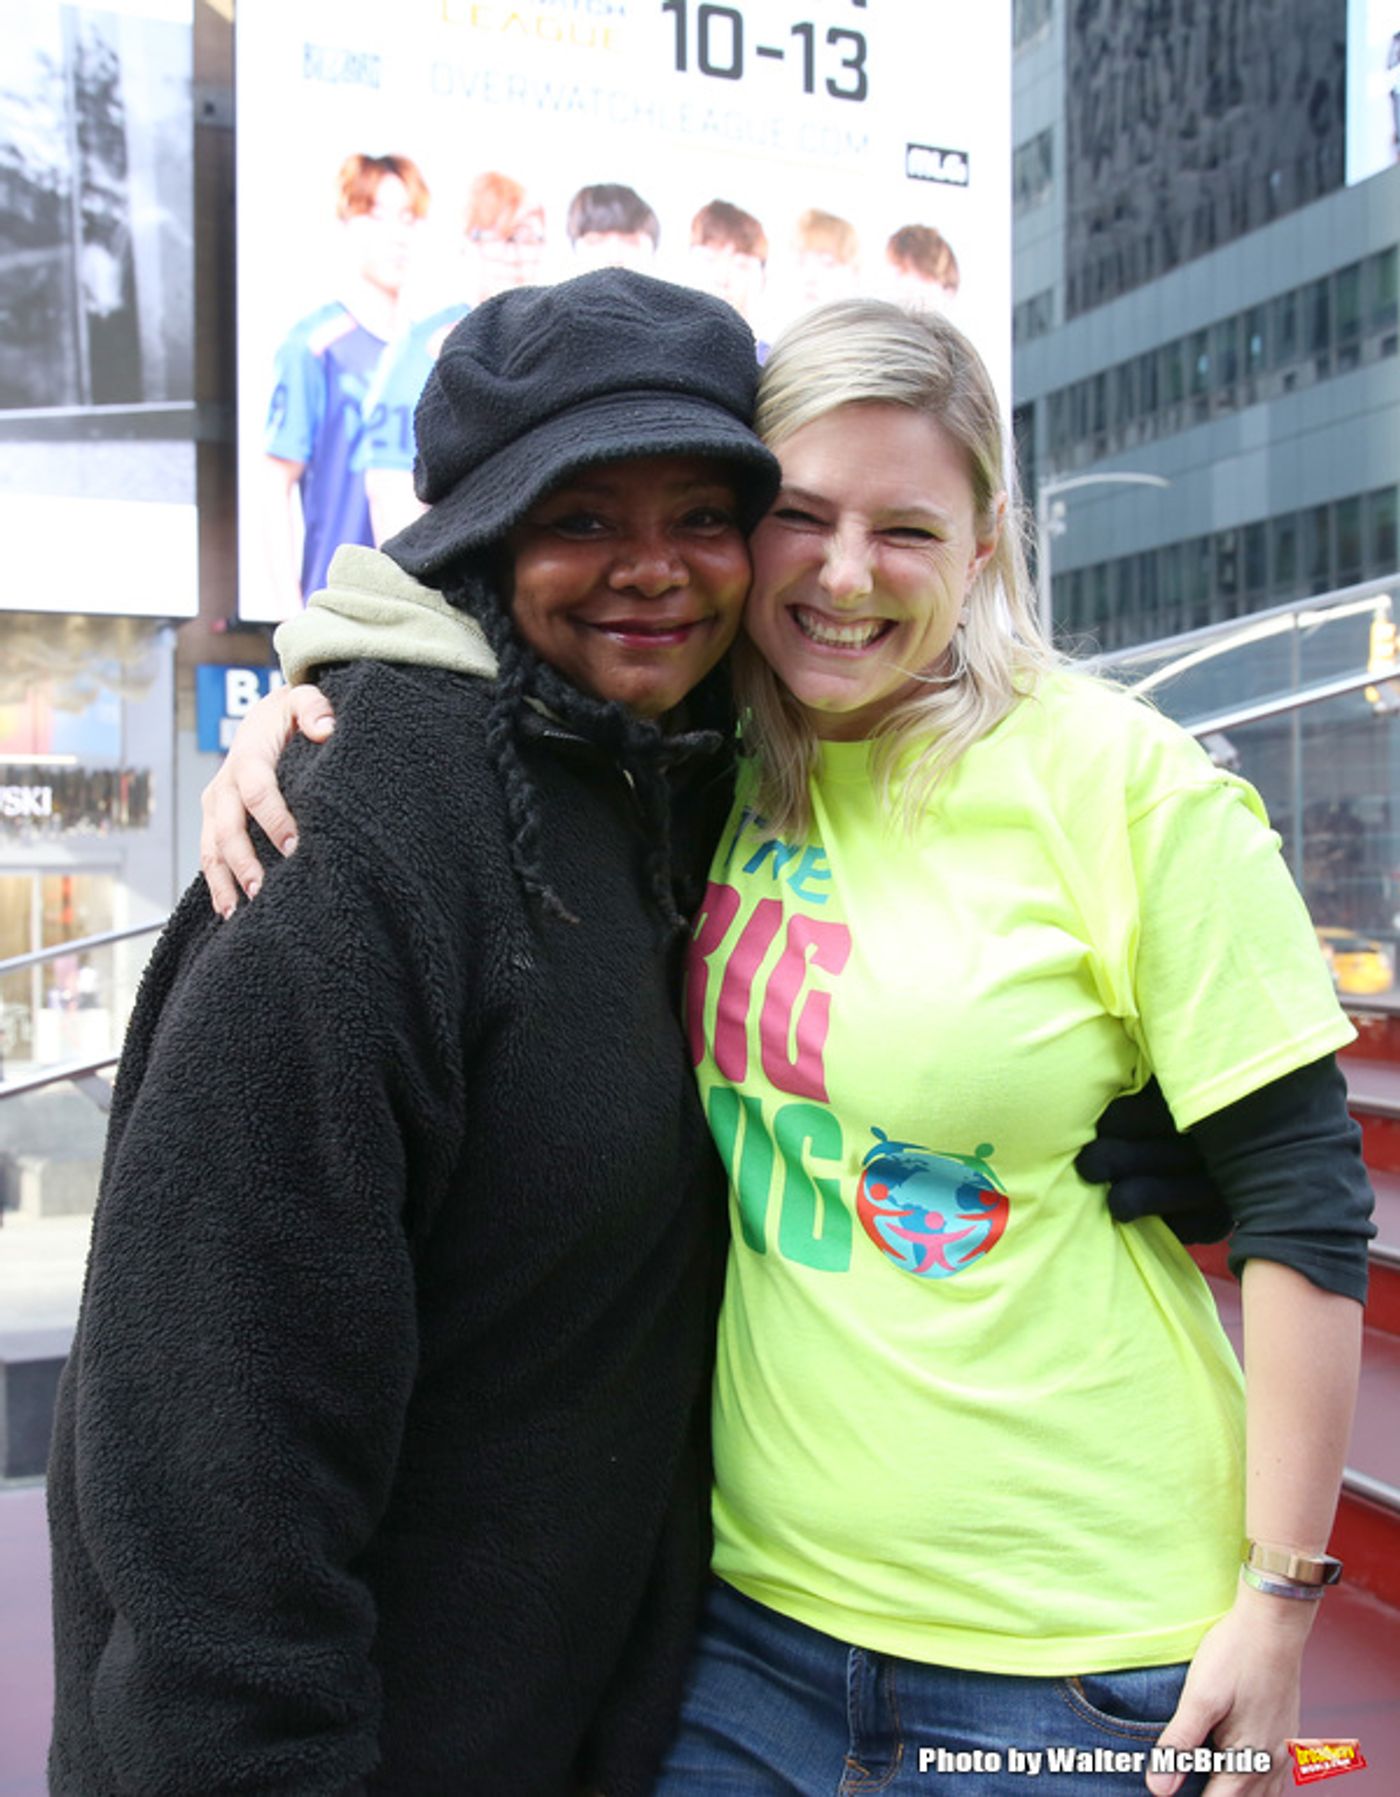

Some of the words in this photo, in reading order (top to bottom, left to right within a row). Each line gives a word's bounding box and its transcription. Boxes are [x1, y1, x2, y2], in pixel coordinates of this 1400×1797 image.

[439, 0, 626, 53] LEAGUE
[661, 0, 868, 102] 10-13
[225, 668, 282, 717] B
[0, 786, 52, 817] SKI
